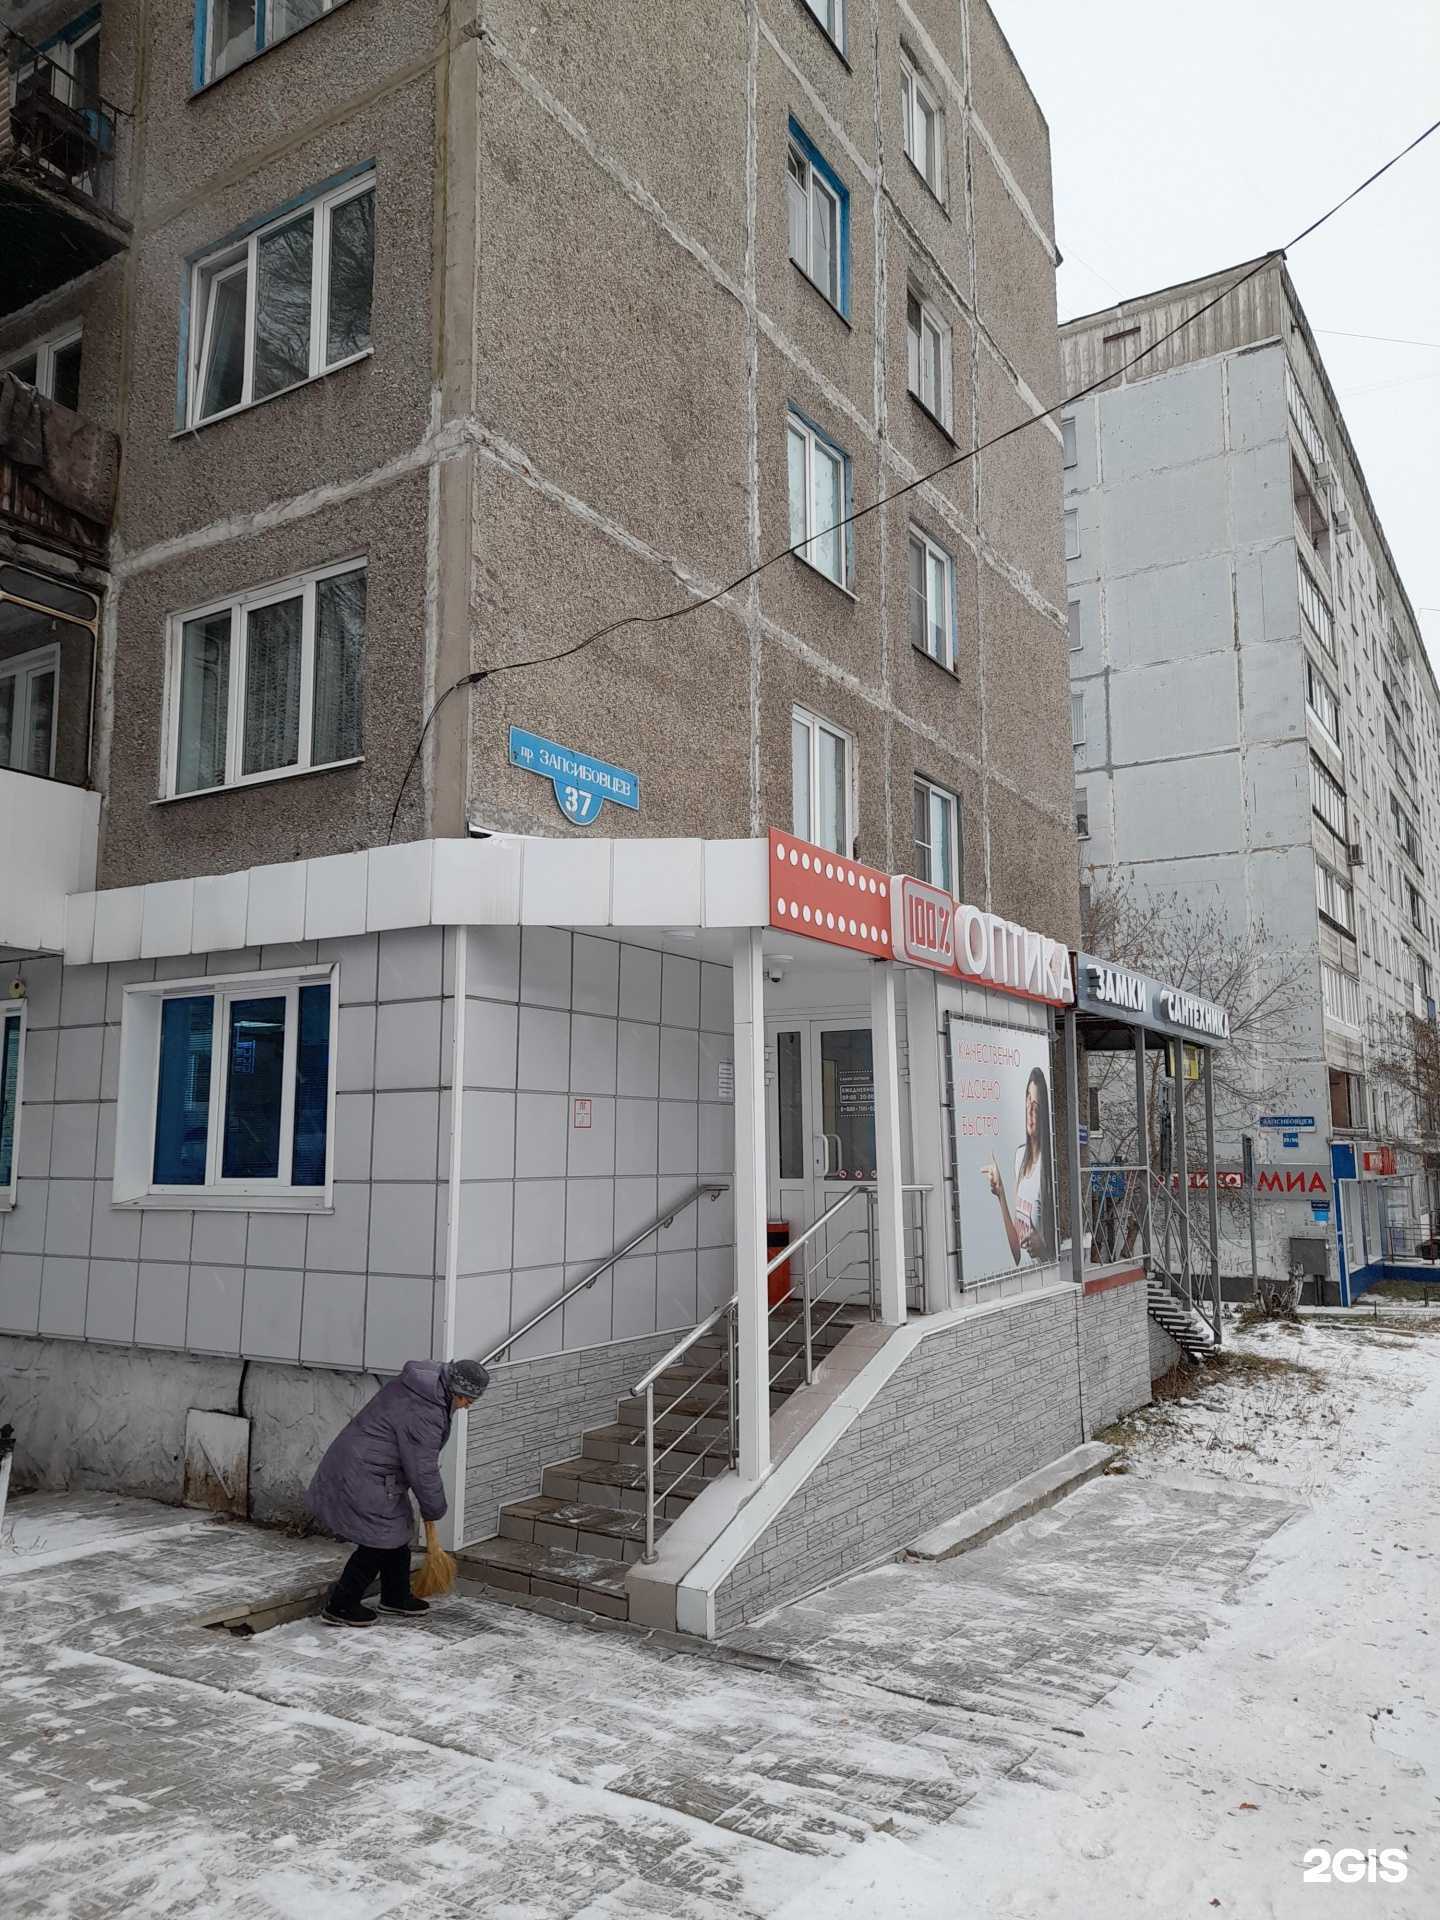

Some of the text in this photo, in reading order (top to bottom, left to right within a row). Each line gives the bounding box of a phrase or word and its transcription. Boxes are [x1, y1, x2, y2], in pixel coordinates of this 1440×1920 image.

[539, 749, 631, 796] ЗАПСИБОВЦЕВ
[564, 785, 592, 817] 37
[909, 894, 1075, 1003] 100% ОПТИКА
[1089, 964, 1231, 1040] ЗАМКИ САНТЕХНИКА
[957, 1040, 1022, 1068] КАЧЕСТВЕННО
[960, 1079, 1001, 1100] УДОБНО
[960, 1115, 1001, 1137] БЫСТРО
[1257, 1170, 1328, 1193] МИА
